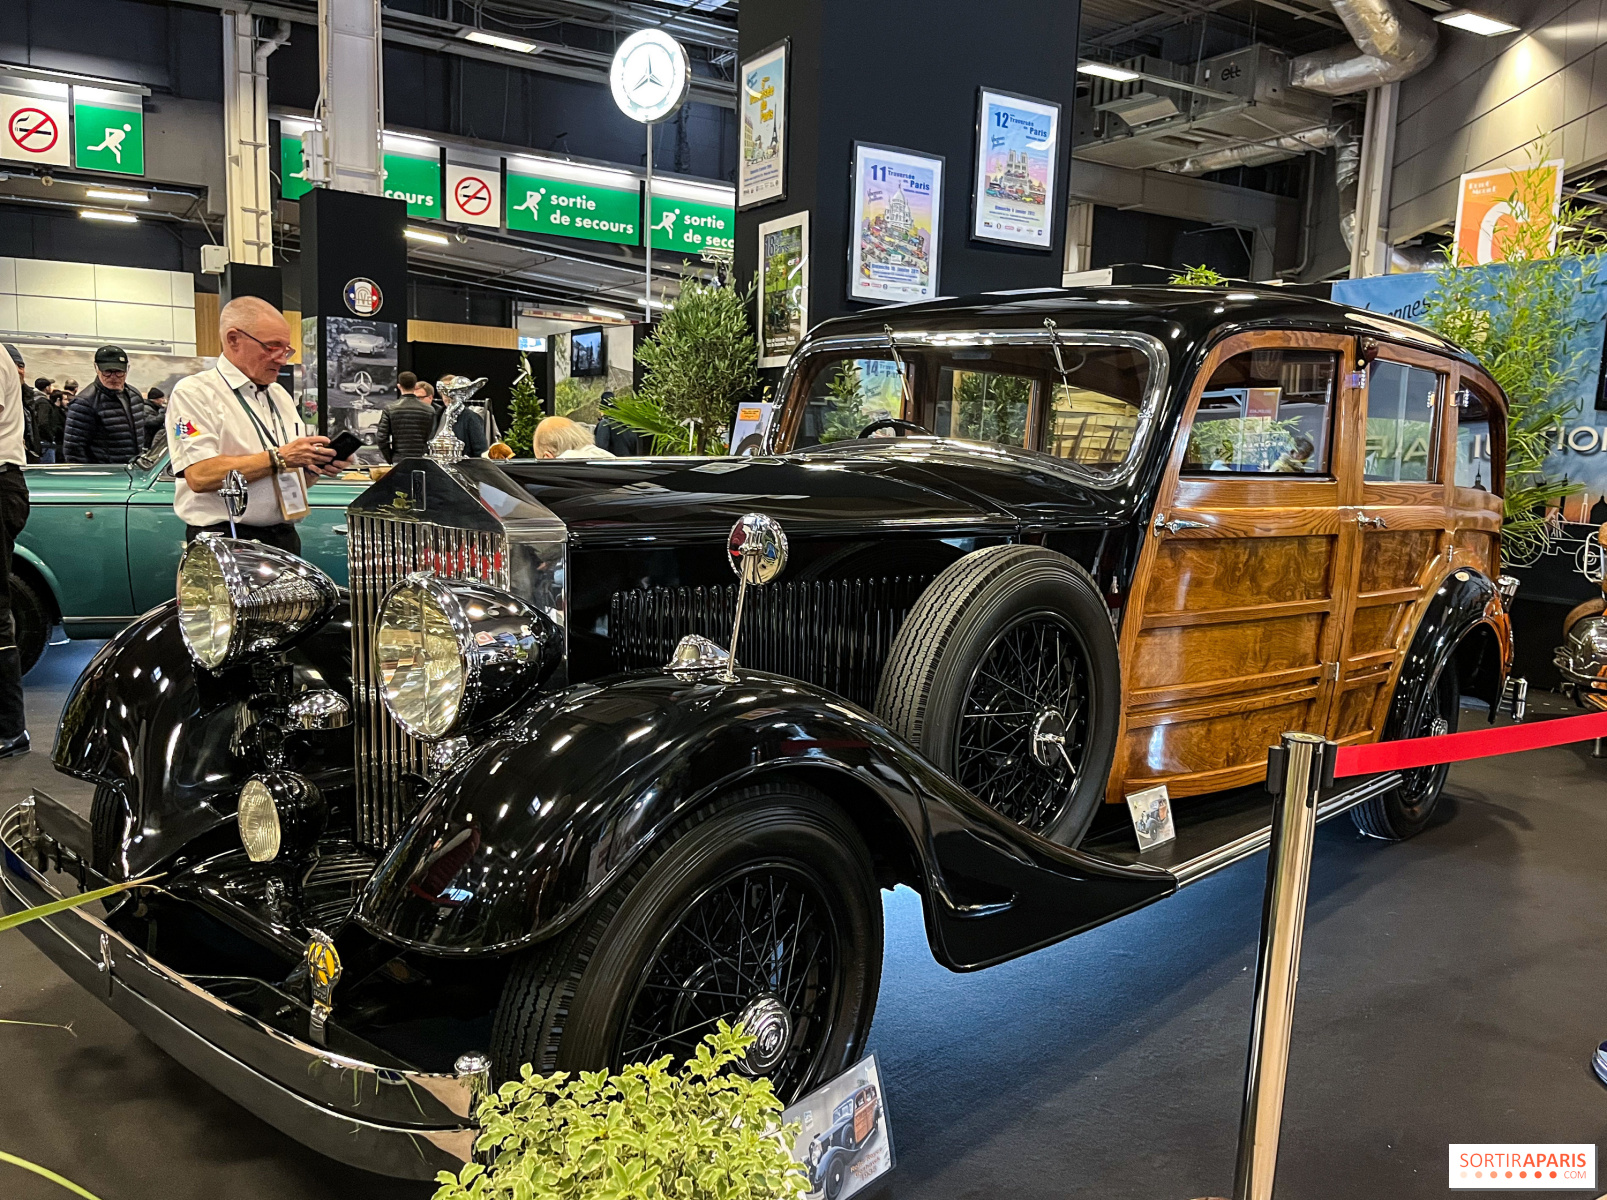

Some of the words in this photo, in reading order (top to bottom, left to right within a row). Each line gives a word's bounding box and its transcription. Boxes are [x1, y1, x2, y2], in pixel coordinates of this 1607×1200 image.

[994, 111, 1009, 129] 12
[1029, 126, 1048, 138] Paris
[870, 164, 887, 182] 11
[909, 180, 930, 191] Paris
[384, 189, 434, 207] cours
[550, 193, 597, 211] sortie
[549, 209, 571, 226] de
[574, 215, 634, 235] secours
[683, 213, 725, 230] sortie
[683, 229, 702, 244] de
[705, 235, 735, 249] seco
